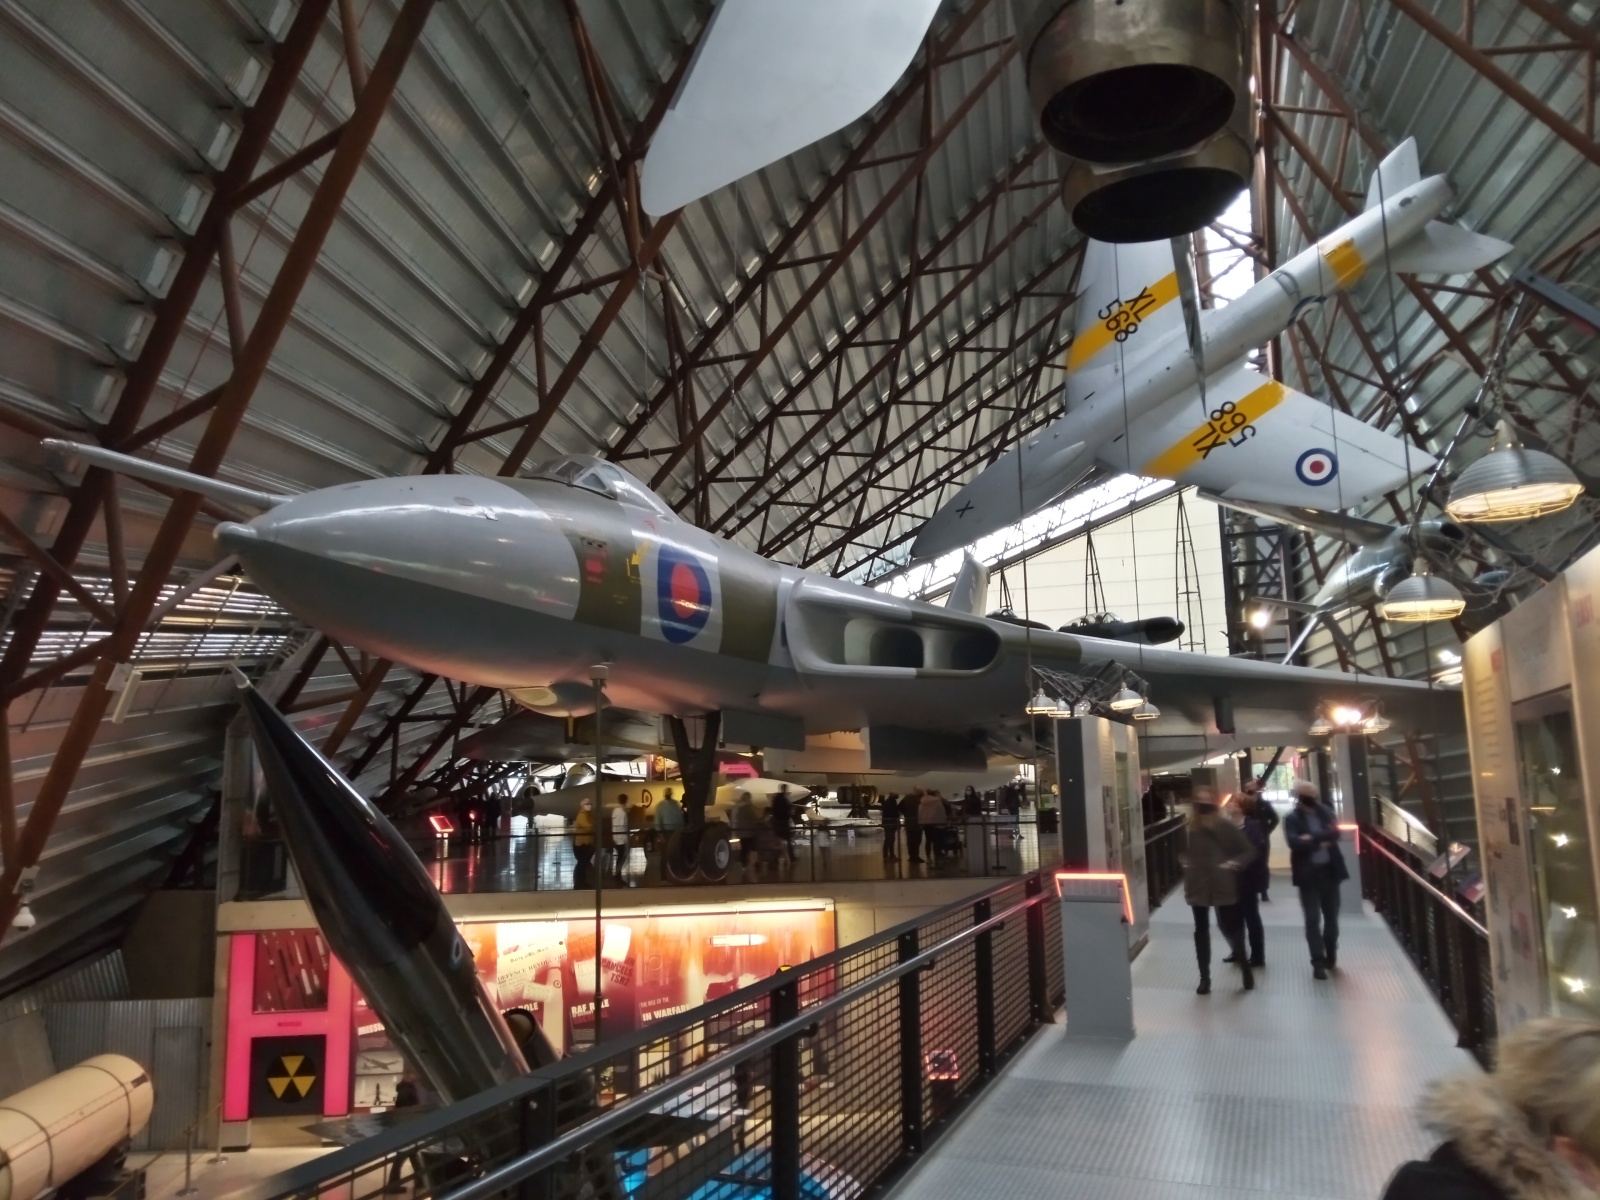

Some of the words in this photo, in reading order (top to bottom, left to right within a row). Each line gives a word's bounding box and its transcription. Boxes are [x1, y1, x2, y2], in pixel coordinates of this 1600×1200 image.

[1097, 296, 1139, 343] 568
[1124, 285, 1156, 323] XL
[1192, 421, 1227, 460] XL
[1209, 400, 1257, 448] 568
[601, 957, 634, 976] CANCELS
[571, 1003, 587, 1016] RAF
[589, 998, 610, 1011] RLE
[642, 1012, 652, 1022] IN
